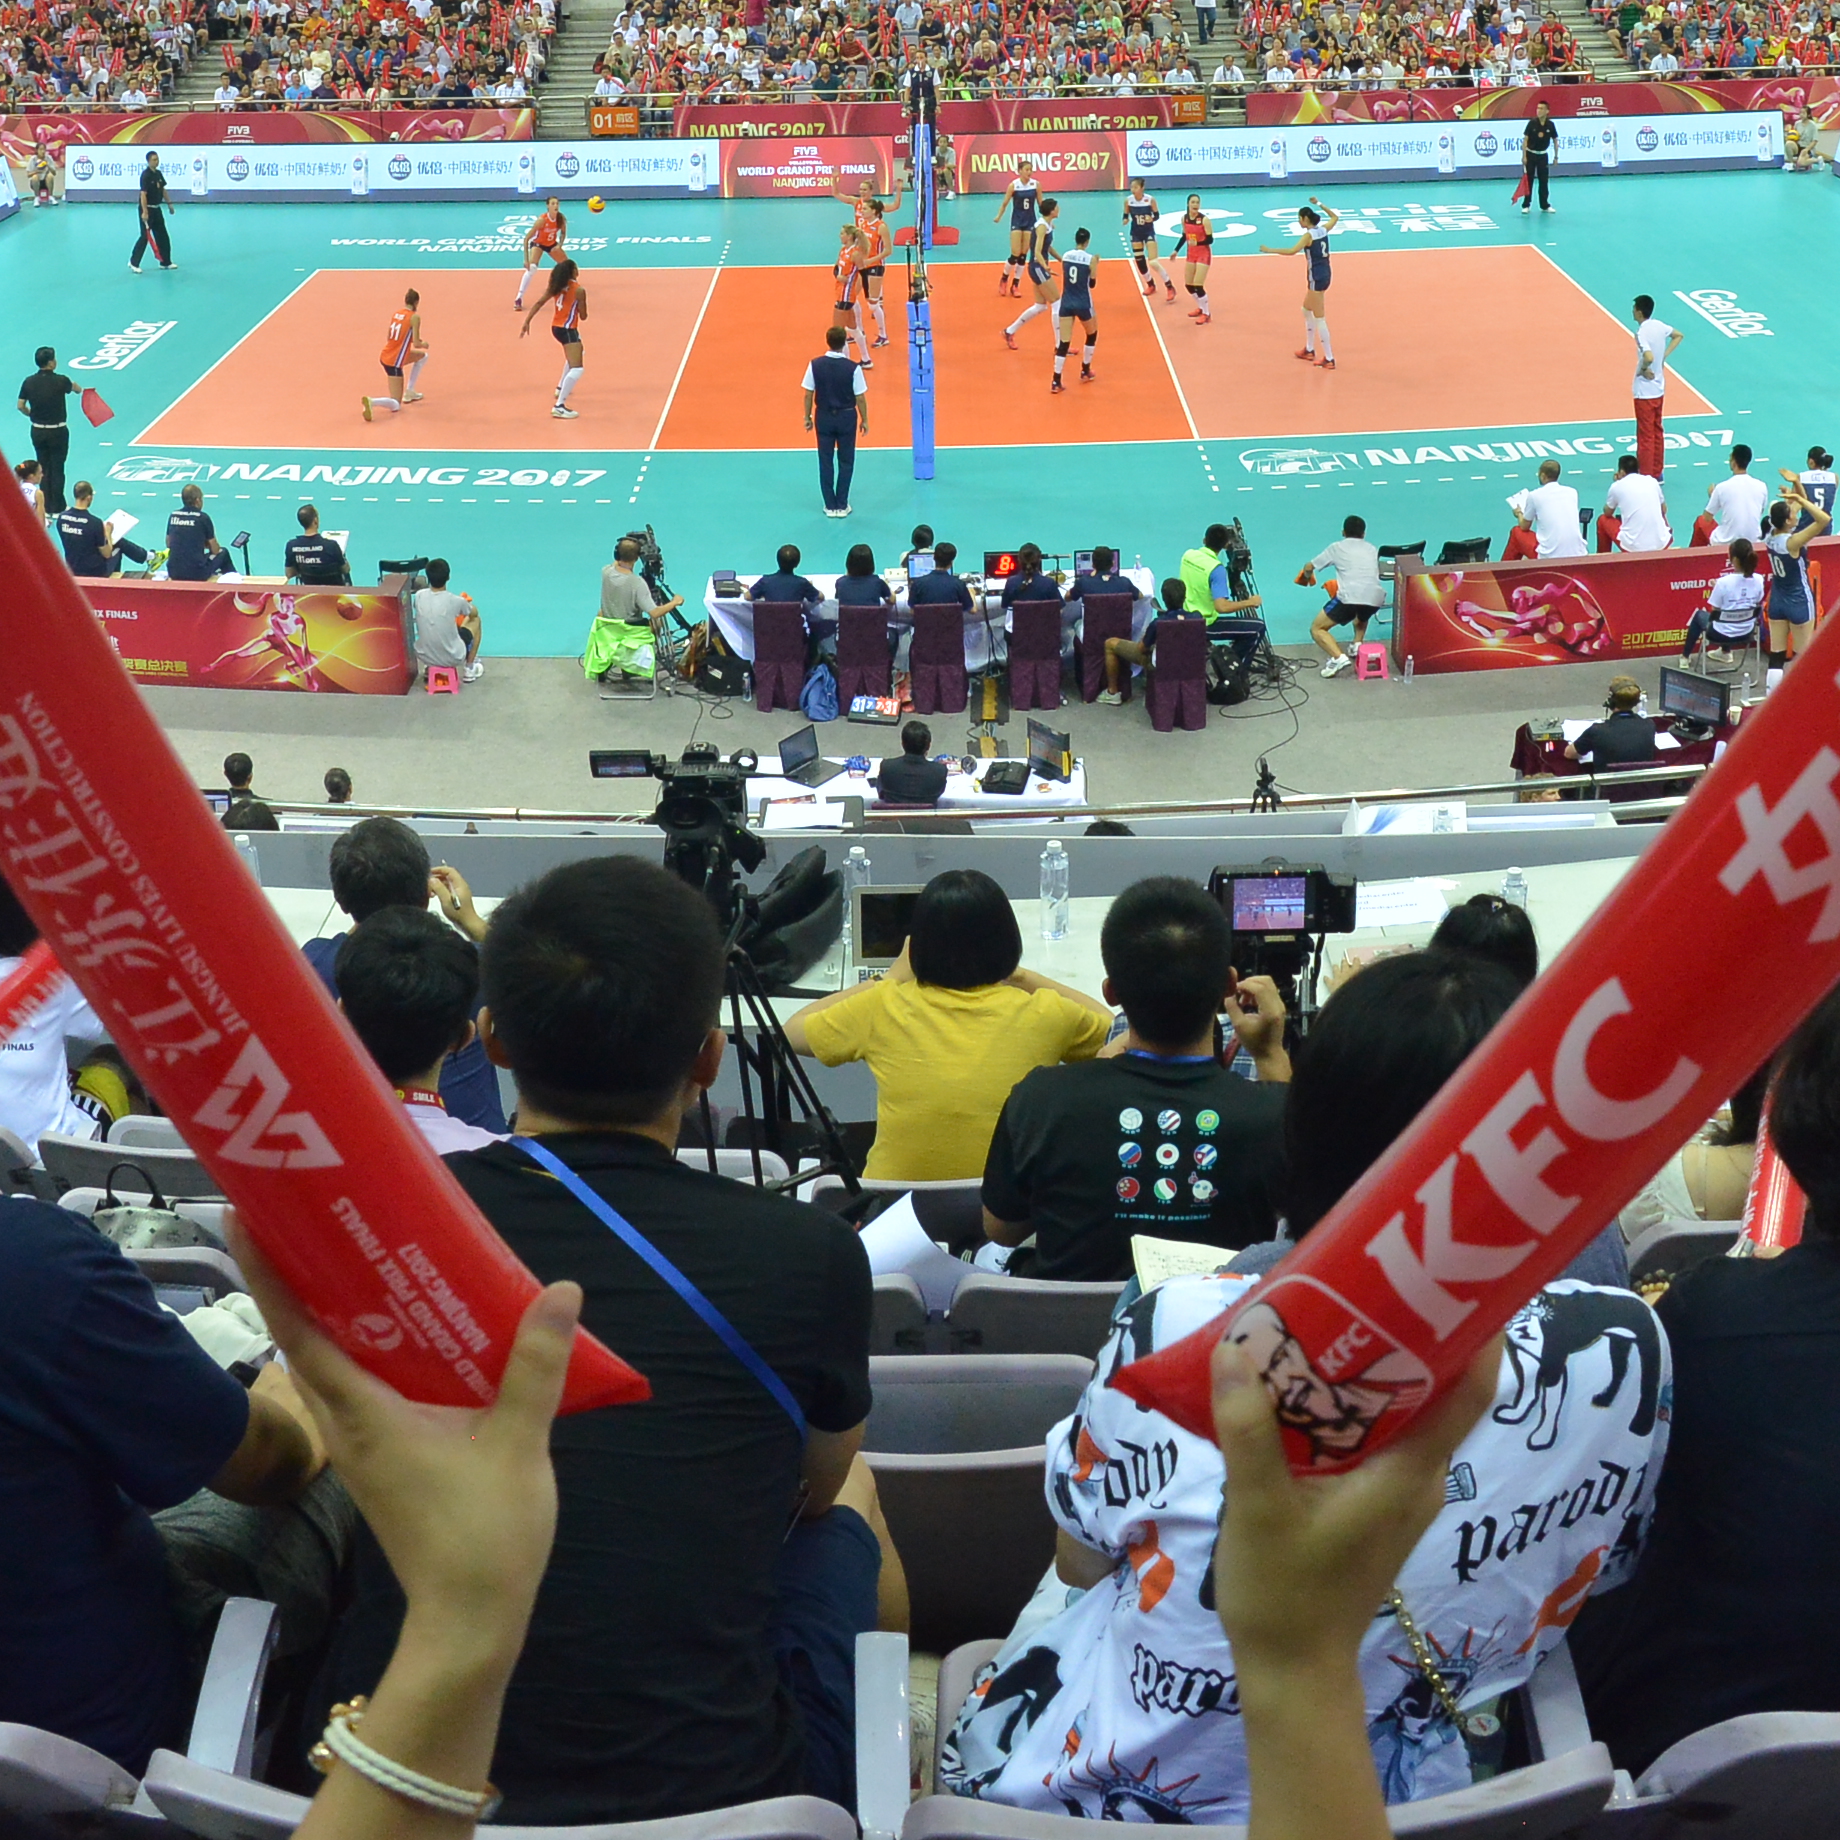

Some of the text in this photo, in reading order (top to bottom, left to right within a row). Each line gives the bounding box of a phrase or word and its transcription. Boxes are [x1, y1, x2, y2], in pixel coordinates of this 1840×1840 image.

[594, 114, 612, 128] 01
[794, 147, 818, 155] FIVB
[737, 165, 875, 176] WORLD GRAND PRI FINALS
[971, 152, 1110, 172] NANJING 2017
[773, 177, 834, 188] NANJING 201
[1069, 266, 1078, 284] 9
[1689, 289, 1774, 337] Gerflor
[390, 322, 402, 340] 11
[68, 320, 166, 370] Gerflor
[1364, 437, 1616, 466] NANJING
[219, 463, 608, 487] NANJING 2017
[1814, 489, 1825, 510] 5
[851, 697, 866, 712] 31
[884, 700, 899, 715] 31
[16, 692, 249, 1034] JIANGSU LIVES CONSTRUCTION
[1365, 980, 1702, 1341] KFC
[1319, 1322, 1371, 1377] KFC
